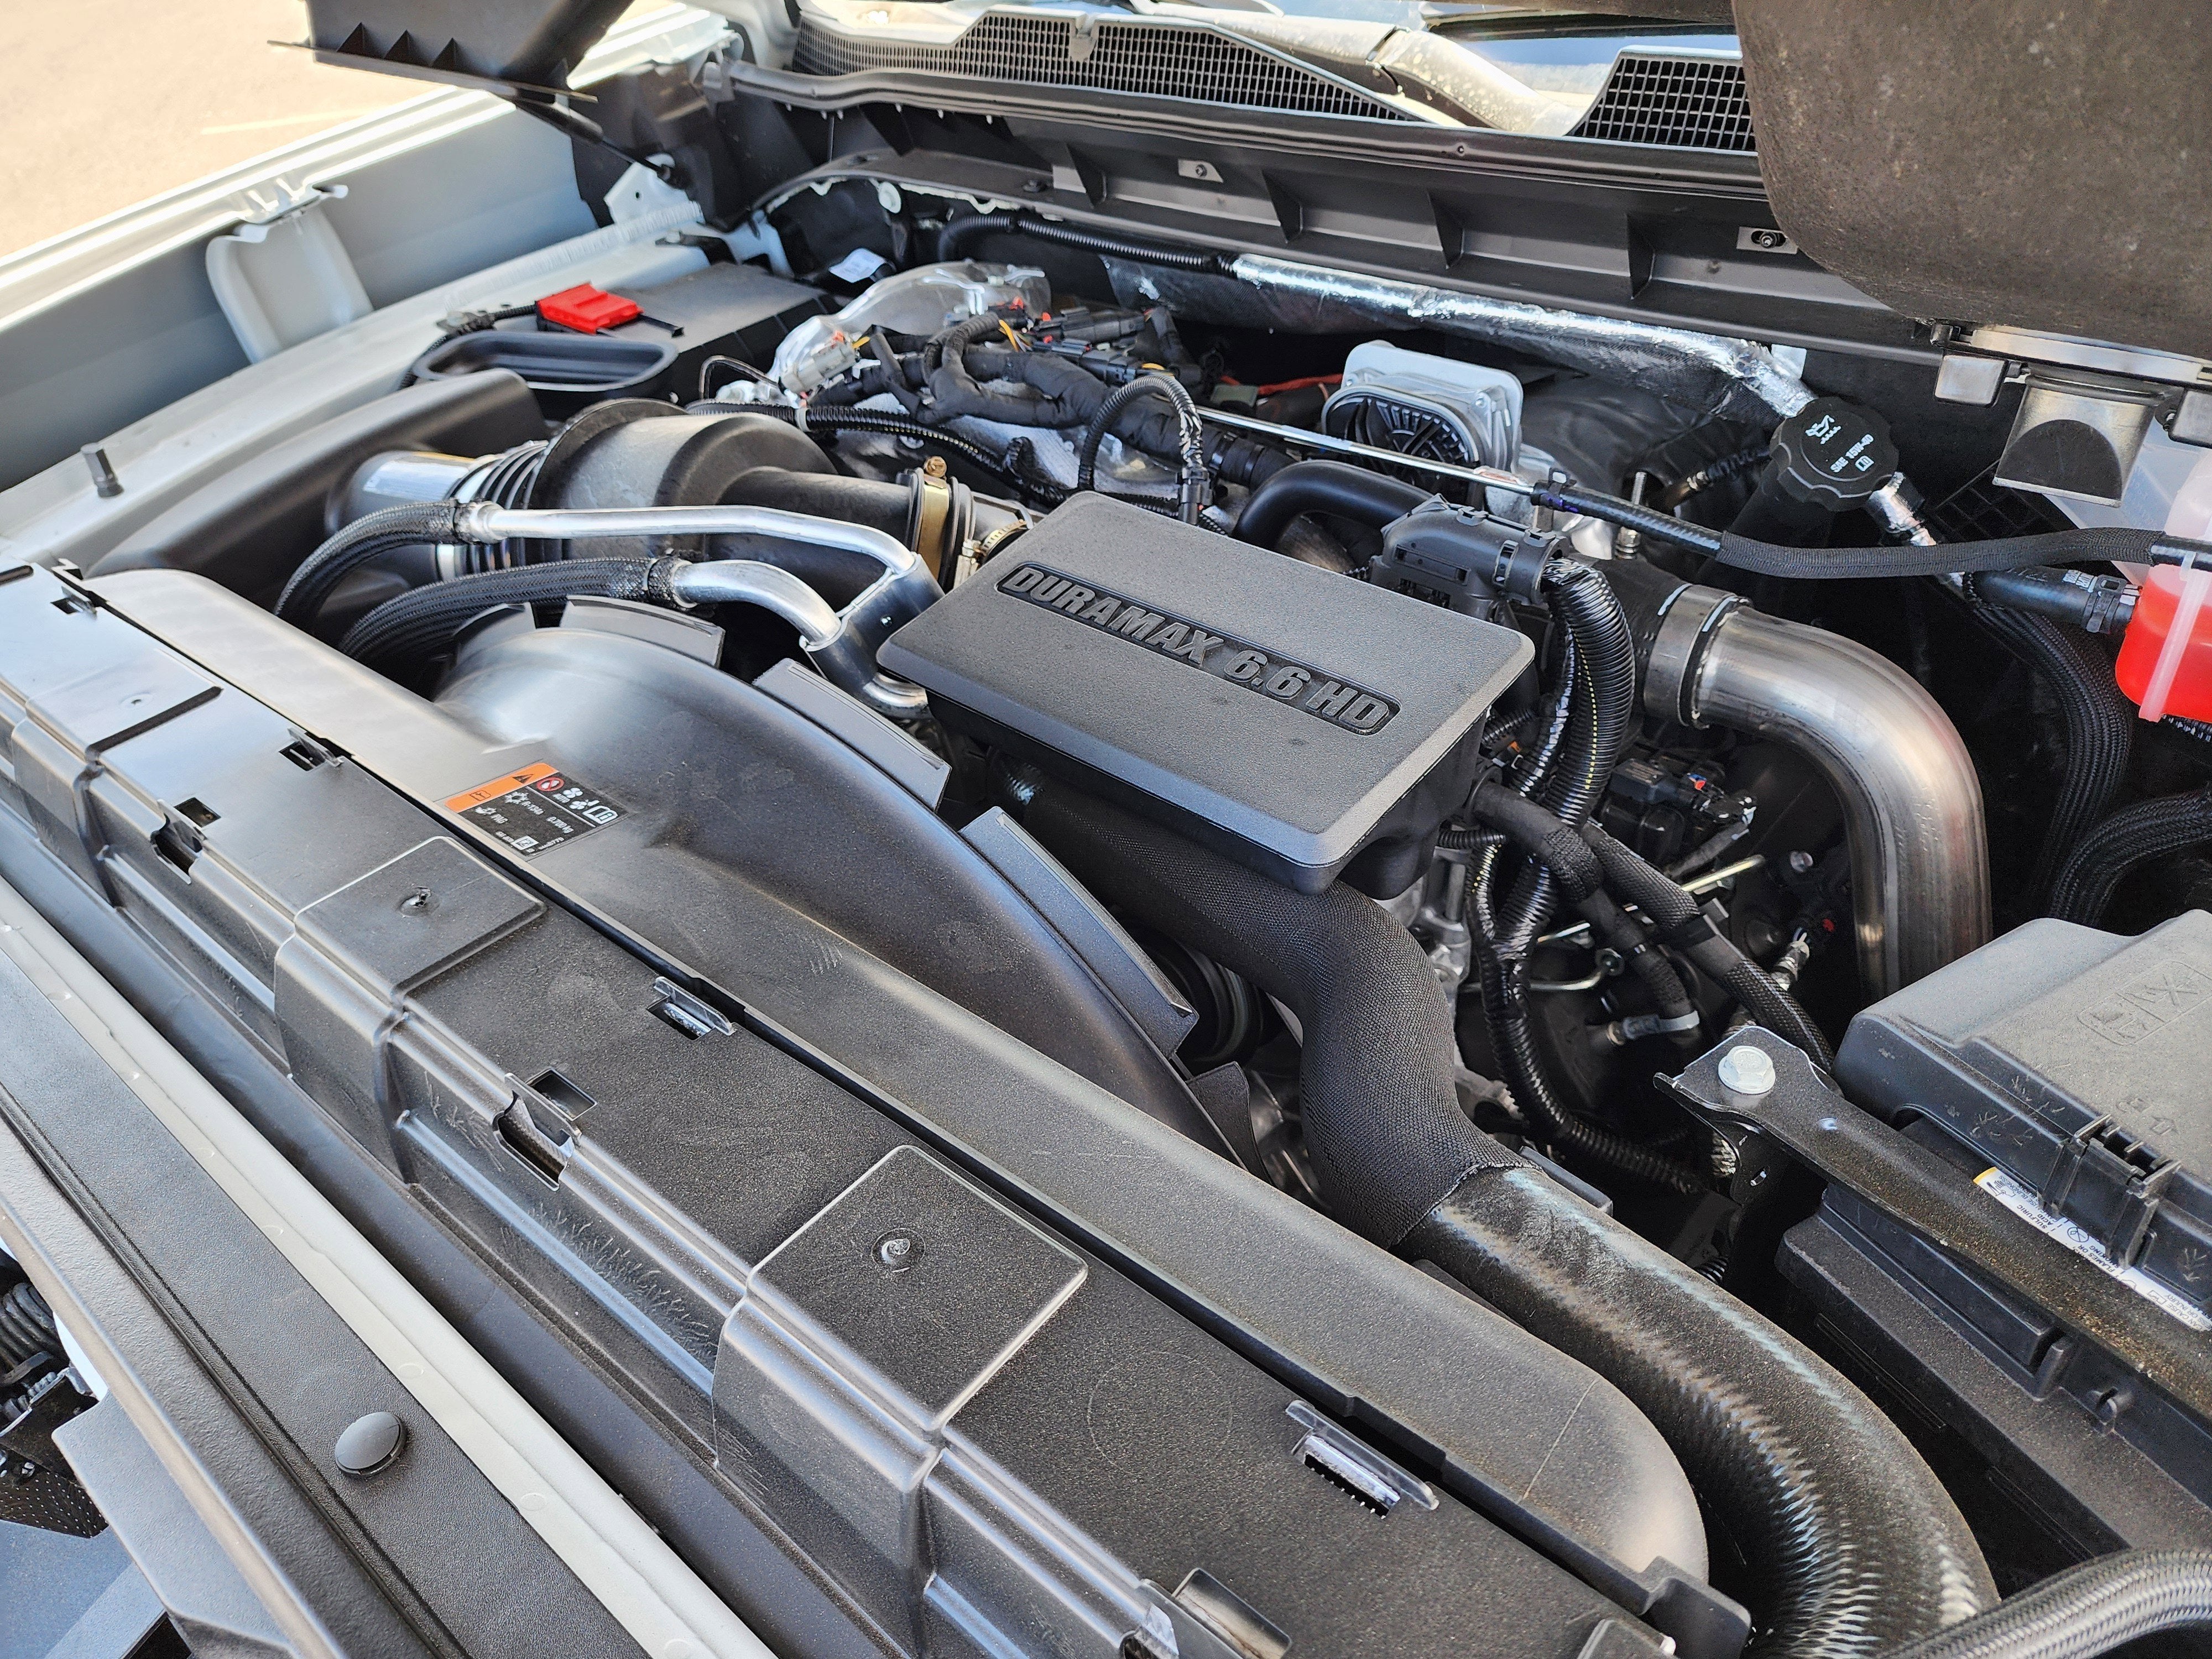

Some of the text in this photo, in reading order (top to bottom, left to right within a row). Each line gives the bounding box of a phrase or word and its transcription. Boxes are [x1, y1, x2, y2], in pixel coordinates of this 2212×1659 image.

[1830, 434, 1874, 473] SAE 15W-40
[1002, 566, 1389, 730] DURAMAX 6.6 HD
[552, 793, 571, 804] AUTO
[490, 813, 508, 824] PAG
[1999, 1175, 2028, 1199] BLINDNESS
[2017, 1204, 2048, 1229] SULFURIC
[2037, 1213, 2053, 1225] ACID
[2078, 1244, 2089, 1253] OR
[2088, 1253, 2115, 1272] FLAMES
[2163, 1294, 2188, 1311] INJURY
[2167, 1303, 2189, 1319] CAUSE
[2187, 1310, 2198, 1318] OR
